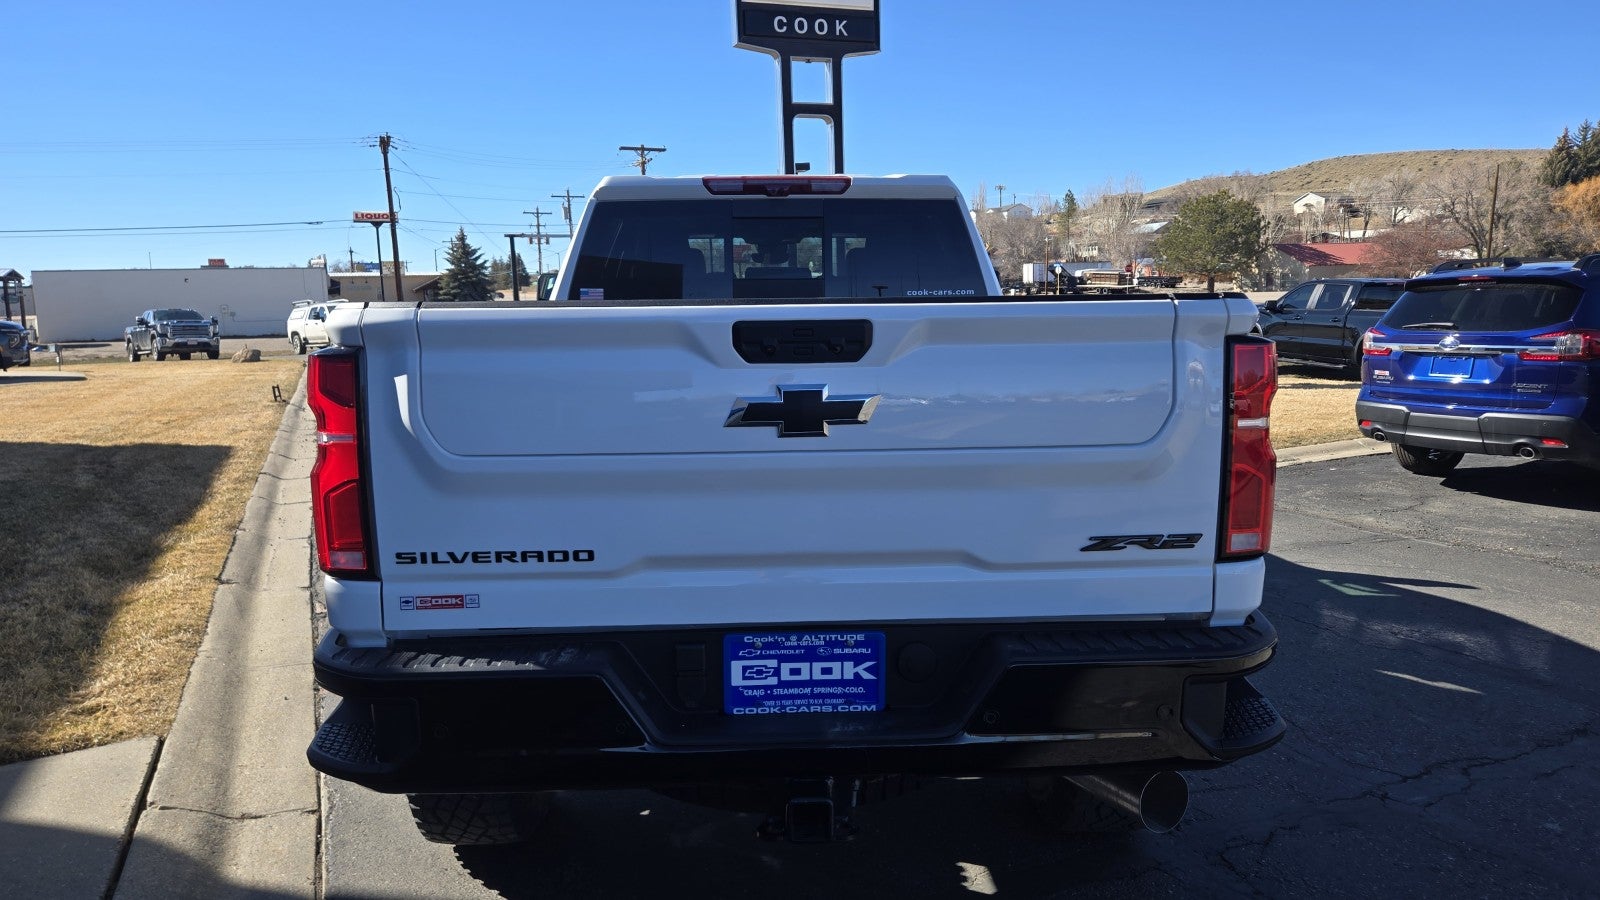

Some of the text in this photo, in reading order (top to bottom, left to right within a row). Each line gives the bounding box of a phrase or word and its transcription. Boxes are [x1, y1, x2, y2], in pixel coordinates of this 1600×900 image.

[773, 15, 848, 37] COOK
[1080, 533, 1203, 552] ZR2
[395, 550, 595, 565] SILVERADO
[744, 635, 786, 643] Cook'n
[801, 634, 865, 642] ALTITUDE
[773, 687, 812, 695] STEAMBOAT
[733, 704, 877, 715] COOK-CARS.COM
